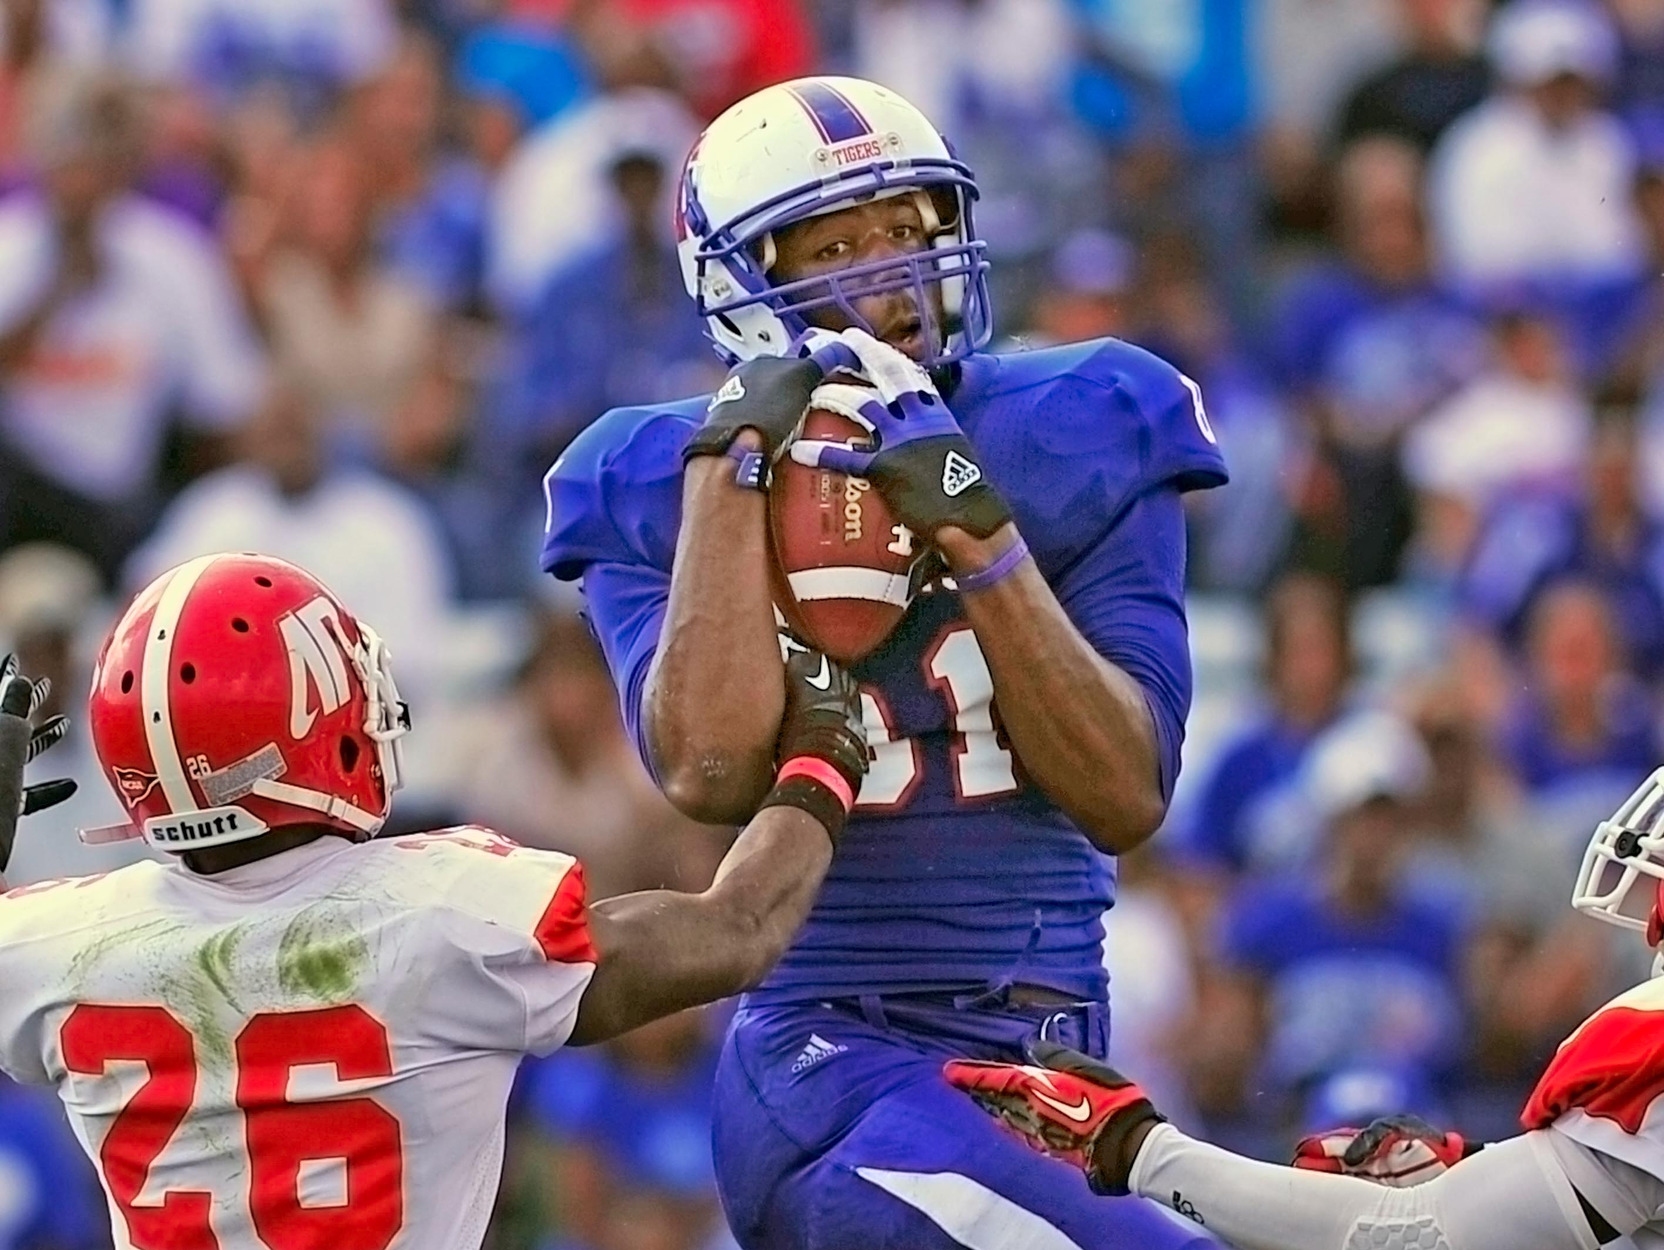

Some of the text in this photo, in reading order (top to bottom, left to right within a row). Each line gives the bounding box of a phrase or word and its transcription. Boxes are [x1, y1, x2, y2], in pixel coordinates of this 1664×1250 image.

[832, 140, 881, 166] TIGERS
[186, 754, 212, 780] 26
[152, 813, 237, 841] schutt
